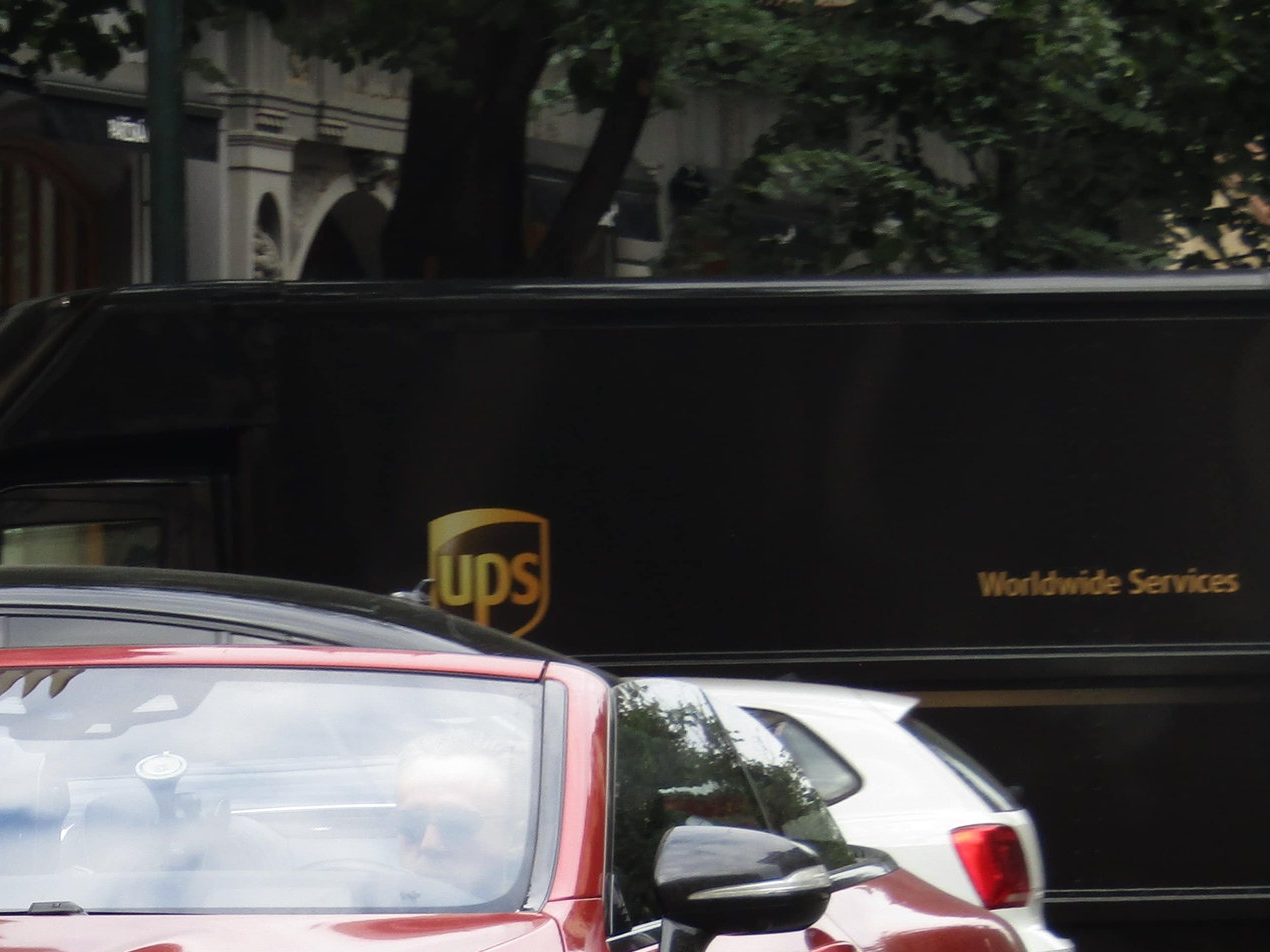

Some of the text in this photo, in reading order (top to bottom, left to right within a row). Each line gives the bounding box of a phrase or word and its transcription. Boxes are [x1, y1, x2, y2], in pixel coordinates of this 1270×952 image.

[437, 552, 540, 626] ups
[977, 567, 1240, 598] Worldwide Services
